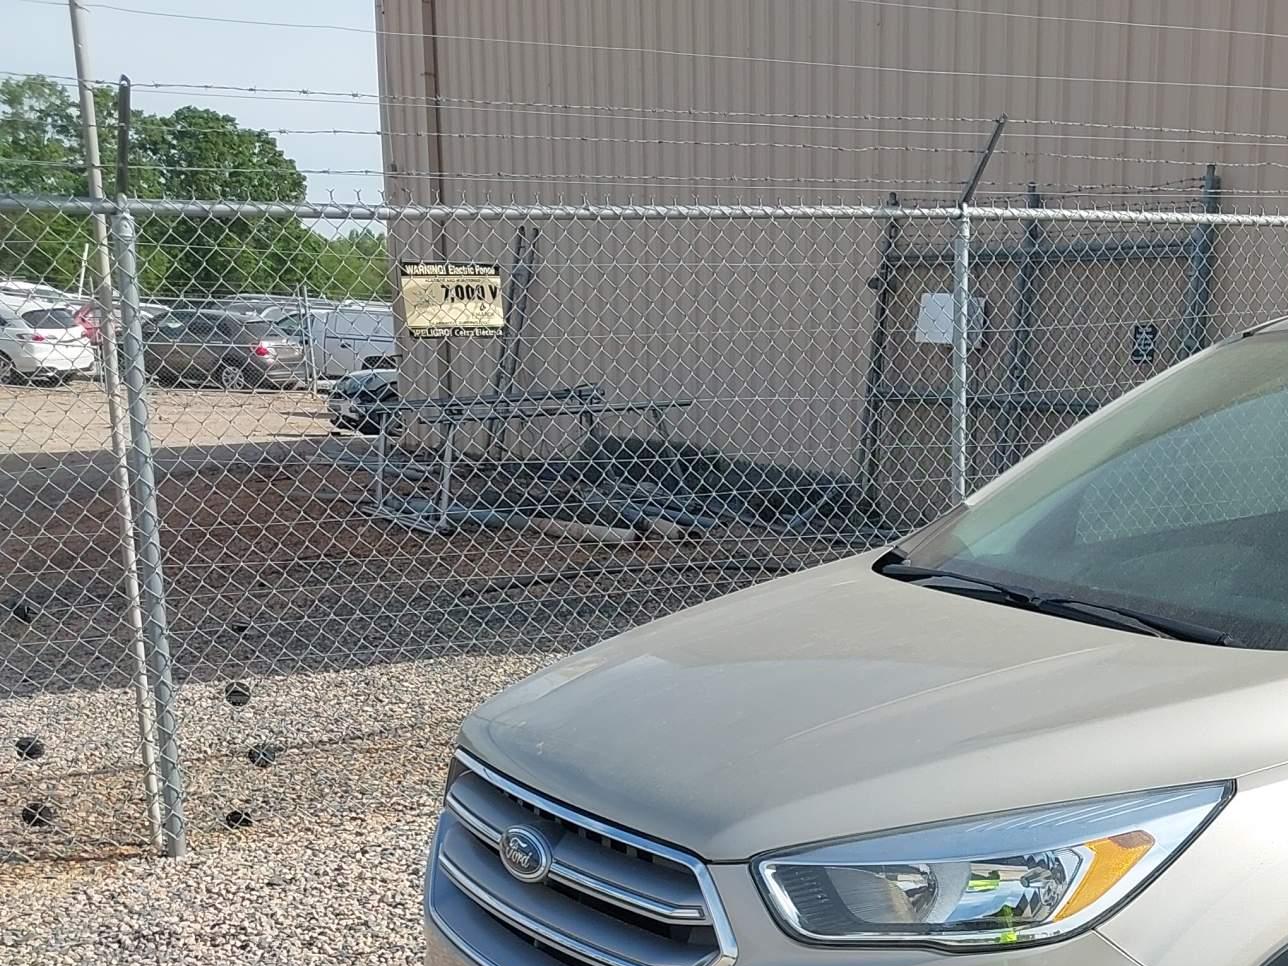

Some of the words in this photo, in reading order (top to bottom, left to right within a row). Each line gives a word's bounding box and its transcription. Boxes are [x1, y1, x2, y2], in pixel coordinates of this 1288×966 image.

[405, 264, 446, 275] WARNING!
[448, 264, 474, 275] Electric
[441, 284, 486, 303] 7,000
[488, 284, 498, 300] V
[505, 837, 533, 868] Ford
